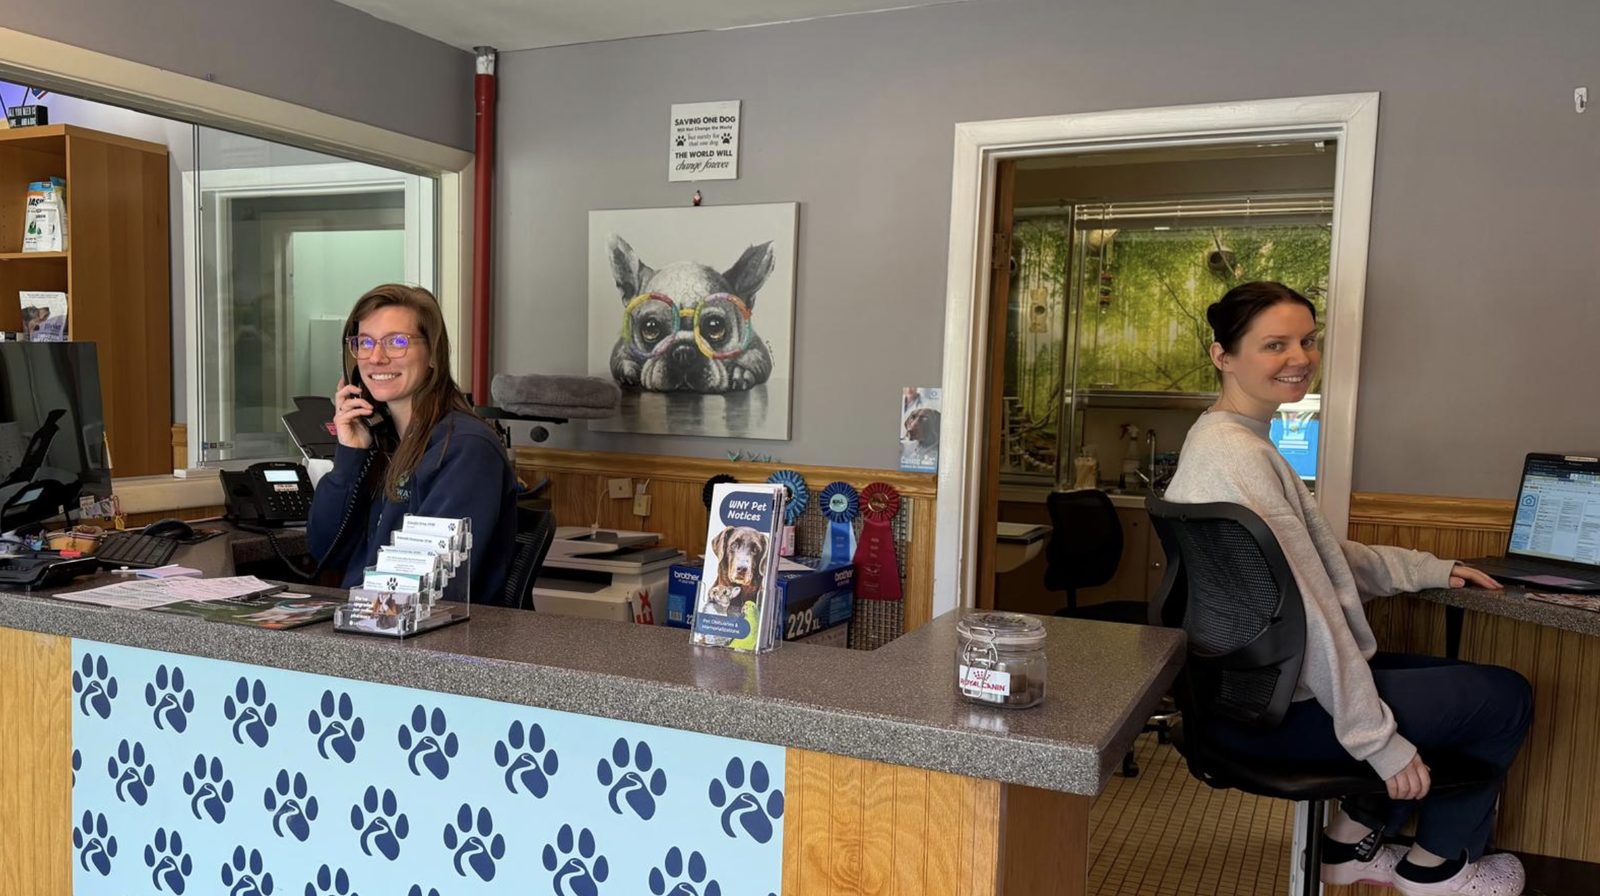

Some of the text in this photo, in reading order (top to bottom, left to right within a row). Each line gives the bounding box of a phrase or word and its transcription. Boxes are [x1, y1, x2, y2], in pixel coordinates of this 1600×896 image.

[675, 117, 701, 126] SAVING
[703, 116, 718, 124] ONE
[689, 150, 715, 158] WORLD
[675, 158, 729, 174] change forever
[729, 500, 767, 511] WNY Pet
[727, 510, 761, 521] Notices
[674, 570, 700, 581] brother
[834, 569, 854, 581] brother
[960, 678, 1005, 691] ROYAL CANIN
